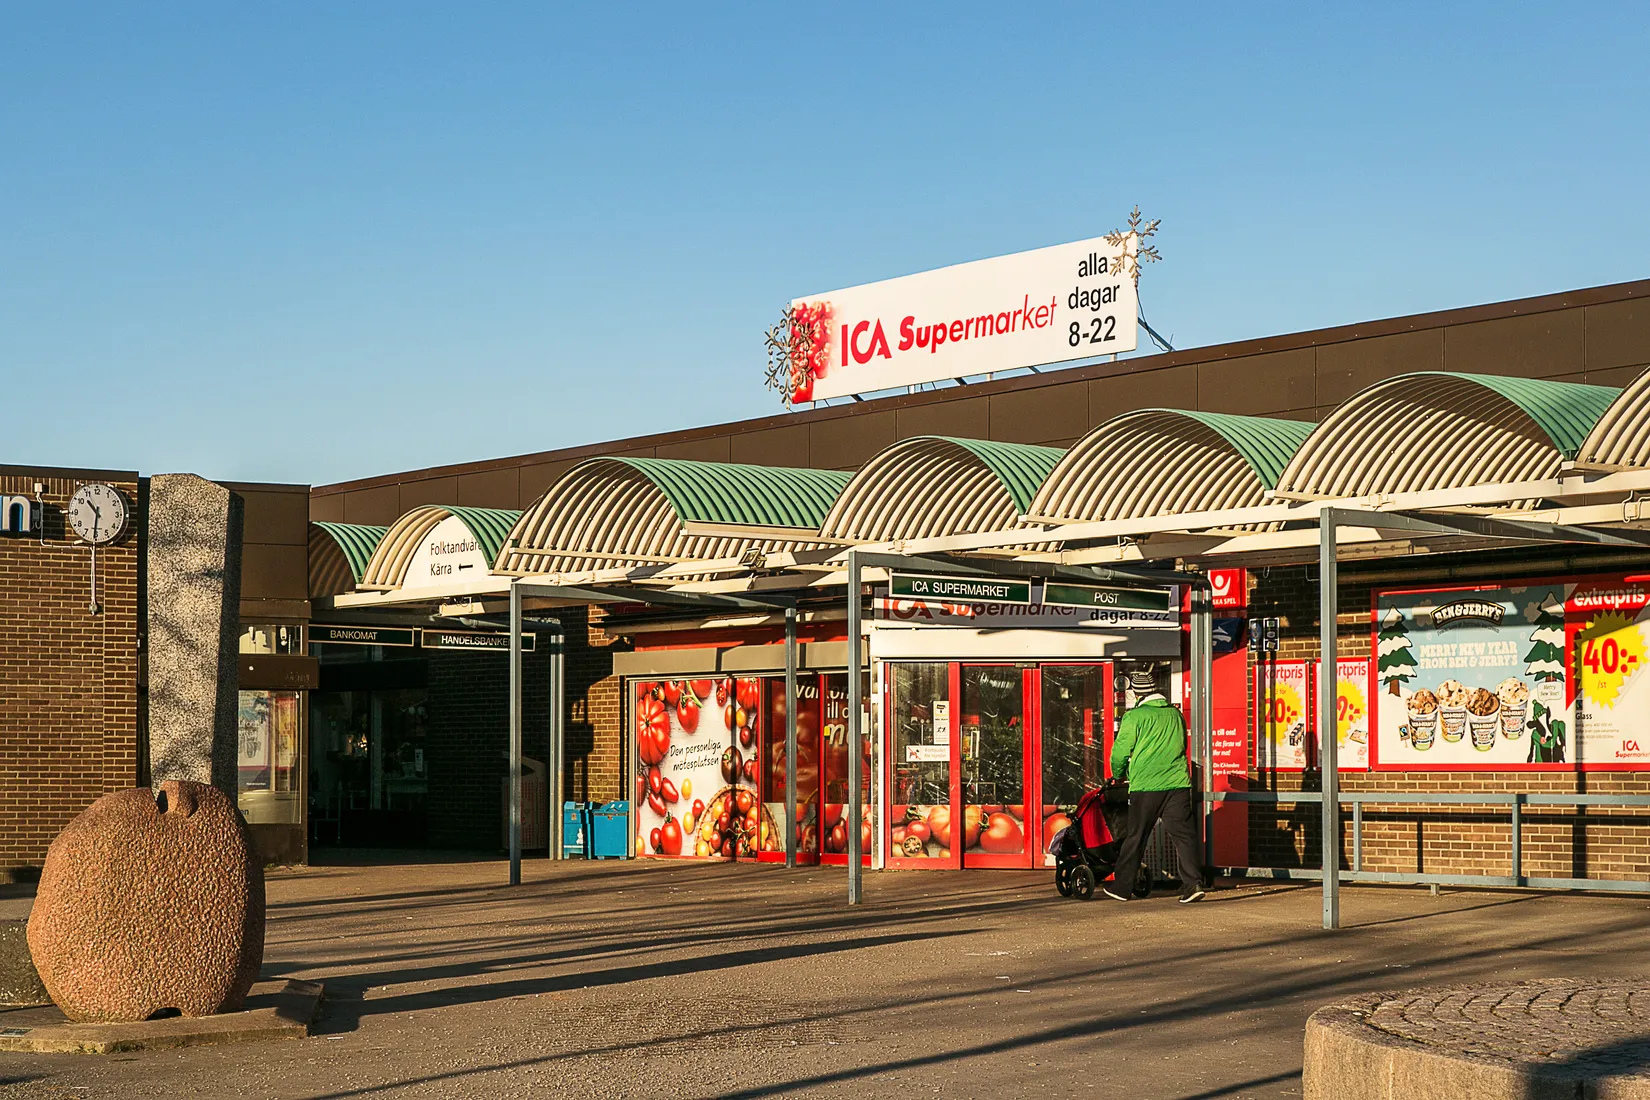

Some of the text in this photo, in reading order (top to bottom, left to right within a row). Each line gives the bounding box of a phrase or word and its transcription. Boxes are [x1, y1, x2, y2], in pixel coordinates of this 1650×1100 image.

[1078, 253, 1108, 278] alla
[1068, 283, 1120, 313] dagar
[842, 294, 1058, 367] ICA Supermarket
[1068, 316, 1116, 348] 8-22
[430, 563, 452, 576] Kärra
[912, 580, 1010, 598] ICA SUPERMARKET
[1574, 584, 1646, 608] extrapris
[1094, 592, 1120, 604] POST
[1090, 608, 1135, 624] dagar
[330, 630, 378, 640] BANKOMAT
[441, 635, 510, 646] HANDELSBANKE
[1420, 641, 1518, 658] MERRY NEW YEAR
[1583, 638, 1638, 674] 40:-
[1420, 658, 1447, 670] FROM
[1448, 657, 1468, 668] BEN
[1479, 654, 1518, 667] JERRY'S
[1265, 666, 1303, 682] kortpris
[1336, 662, 1366, 680] rtpris
[670, 739, 721, 761] Den personliga
[1623, 740, 1640, 751] ICA
[673, 755, 719, 771] mötesplatsen
